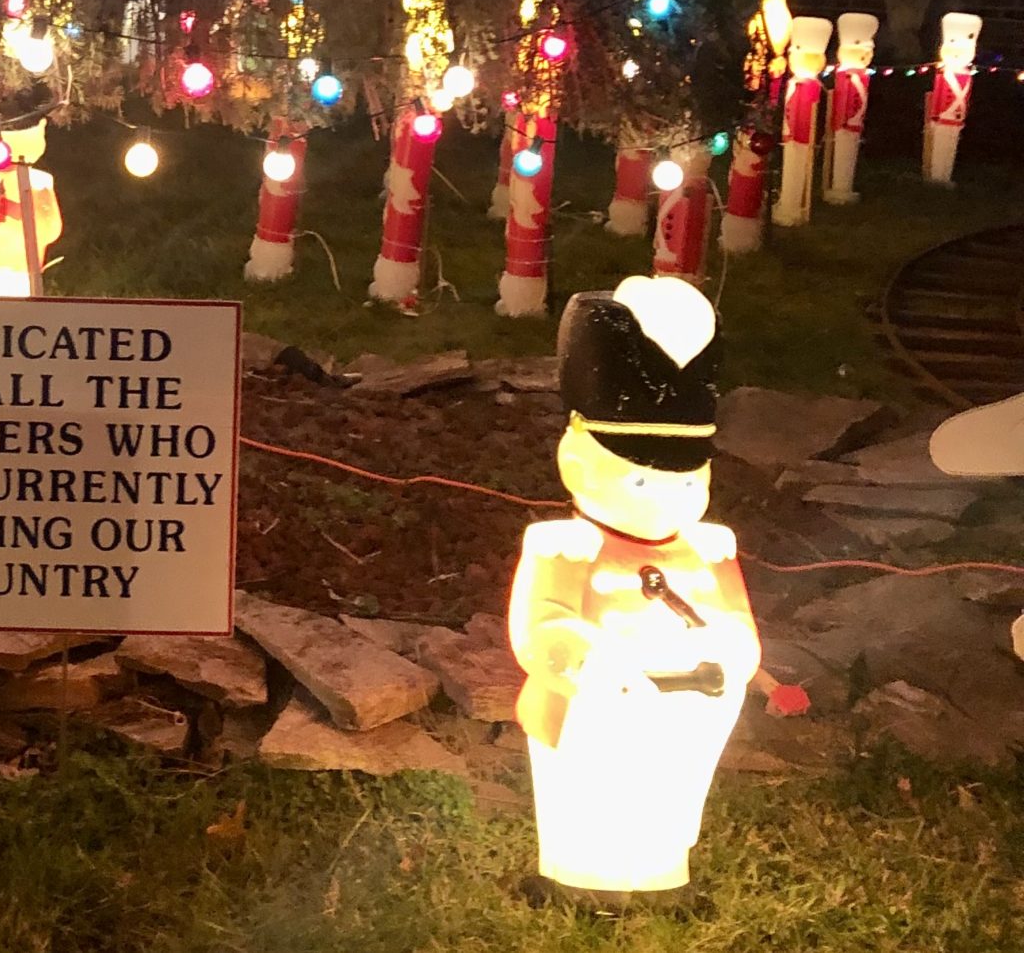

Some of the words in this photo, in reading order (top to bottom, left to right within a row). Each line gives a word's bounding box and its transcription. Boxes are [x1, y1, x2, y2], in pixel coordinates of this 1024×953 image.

[86, 375, 182, 410] THE
[107, 423, 216, 459] WHO
[90, 518, 186, 553] OUR
